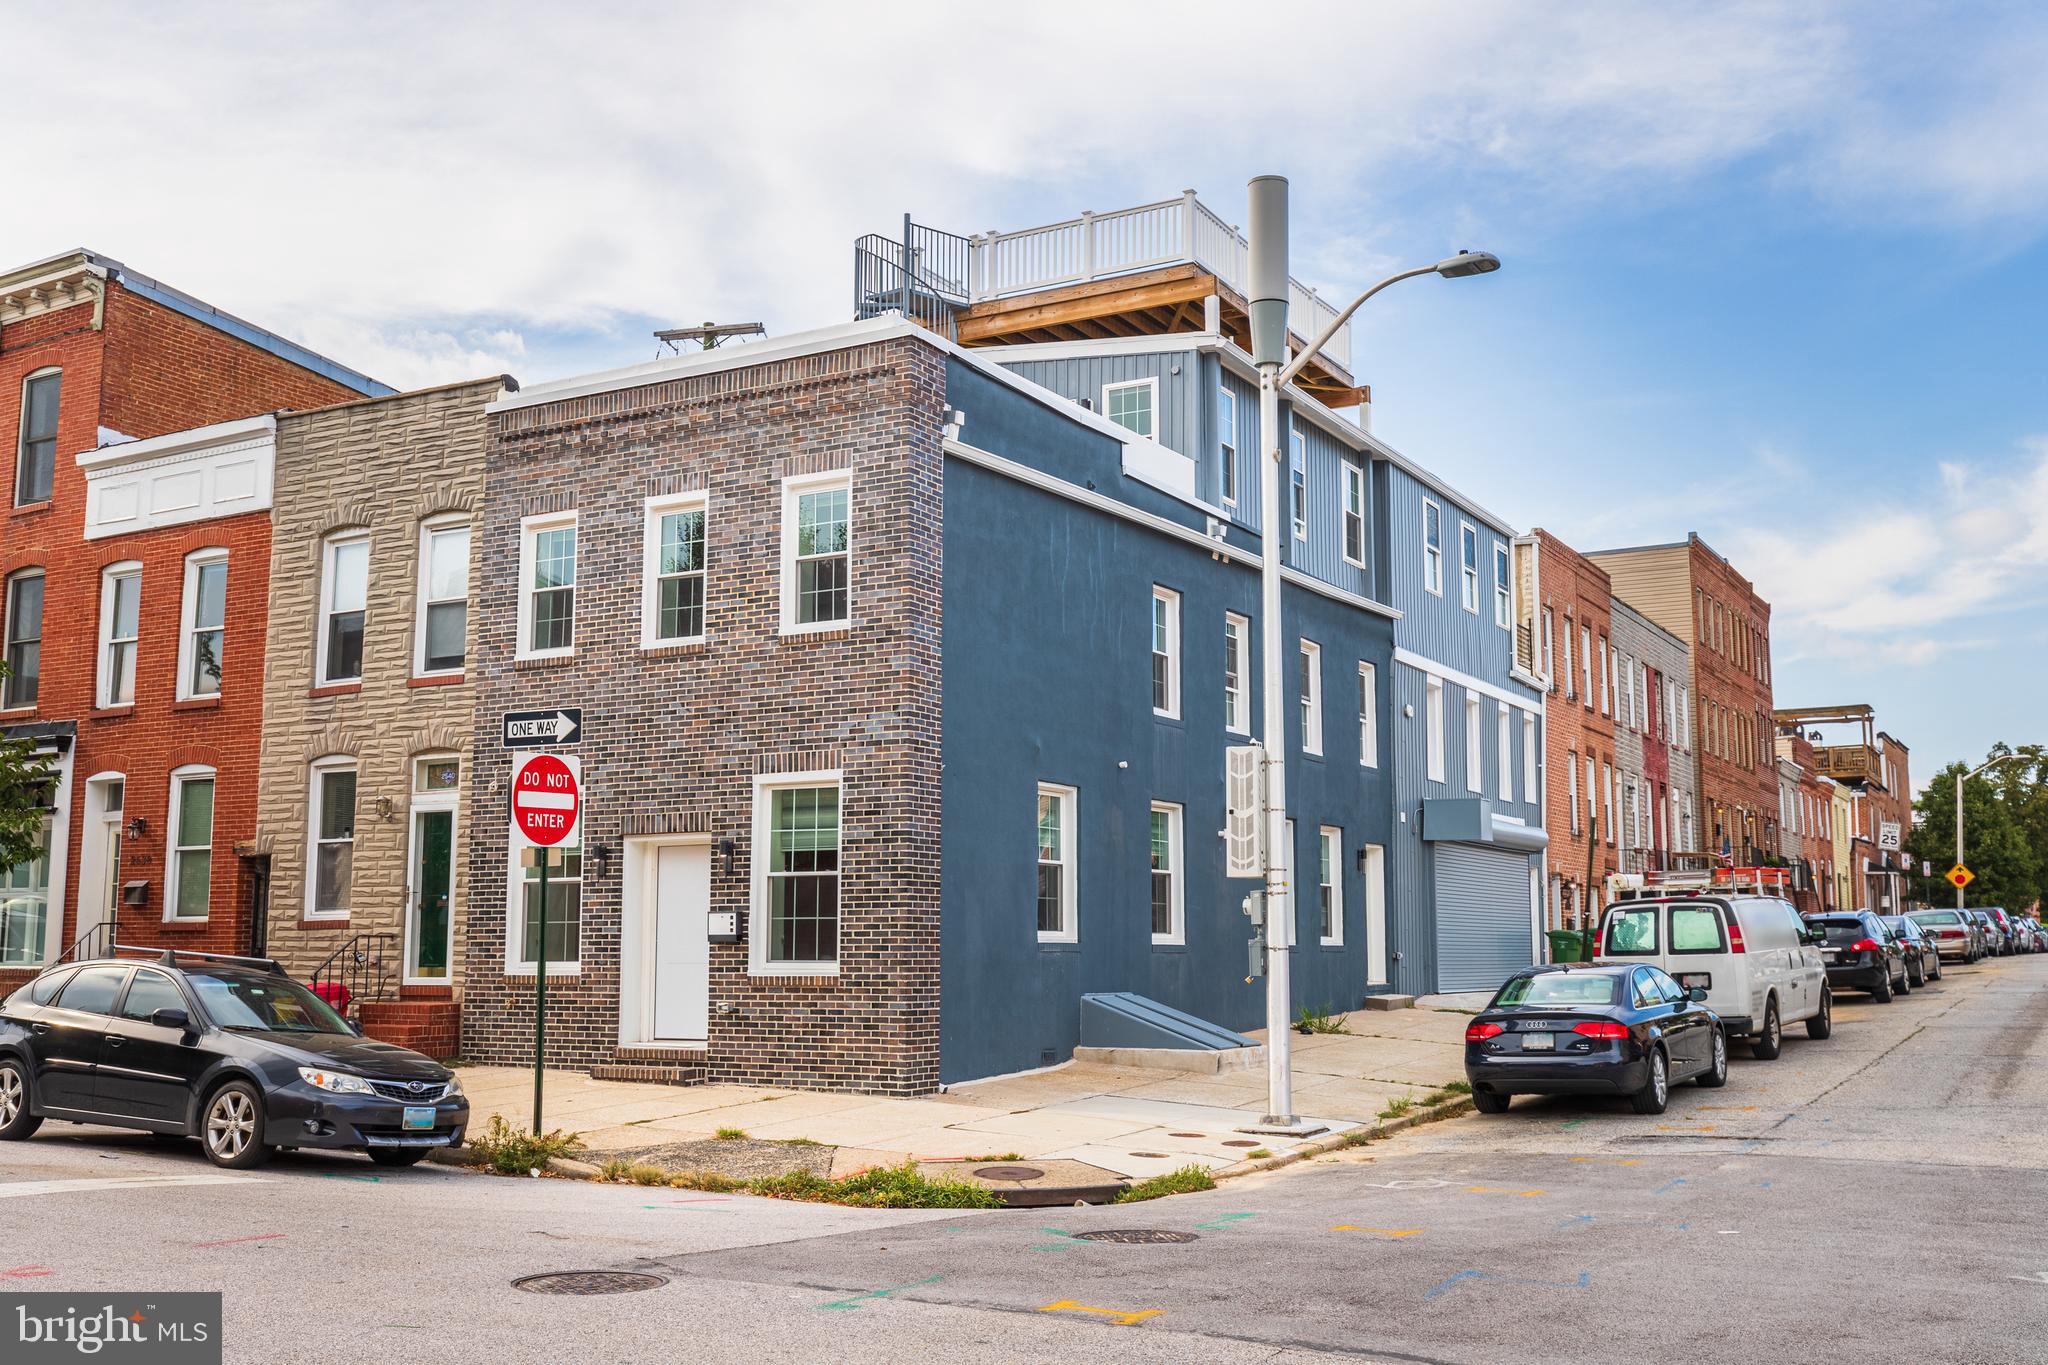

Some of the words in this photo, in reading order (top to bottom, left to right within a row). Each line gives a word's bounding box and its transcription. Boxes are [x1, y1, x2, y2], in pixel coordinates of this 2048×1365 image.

[511, 722, 533, 736] ONE
[536, 720, 559, 735] WAY
[523, 771, 540, 786] DO
[546, 773, 570, 788] NOT
[527, 813, 564, 828] ENTER
[1881, 823, 1899, 831] SPEED
[1881, 834, 1898, 845] 25
